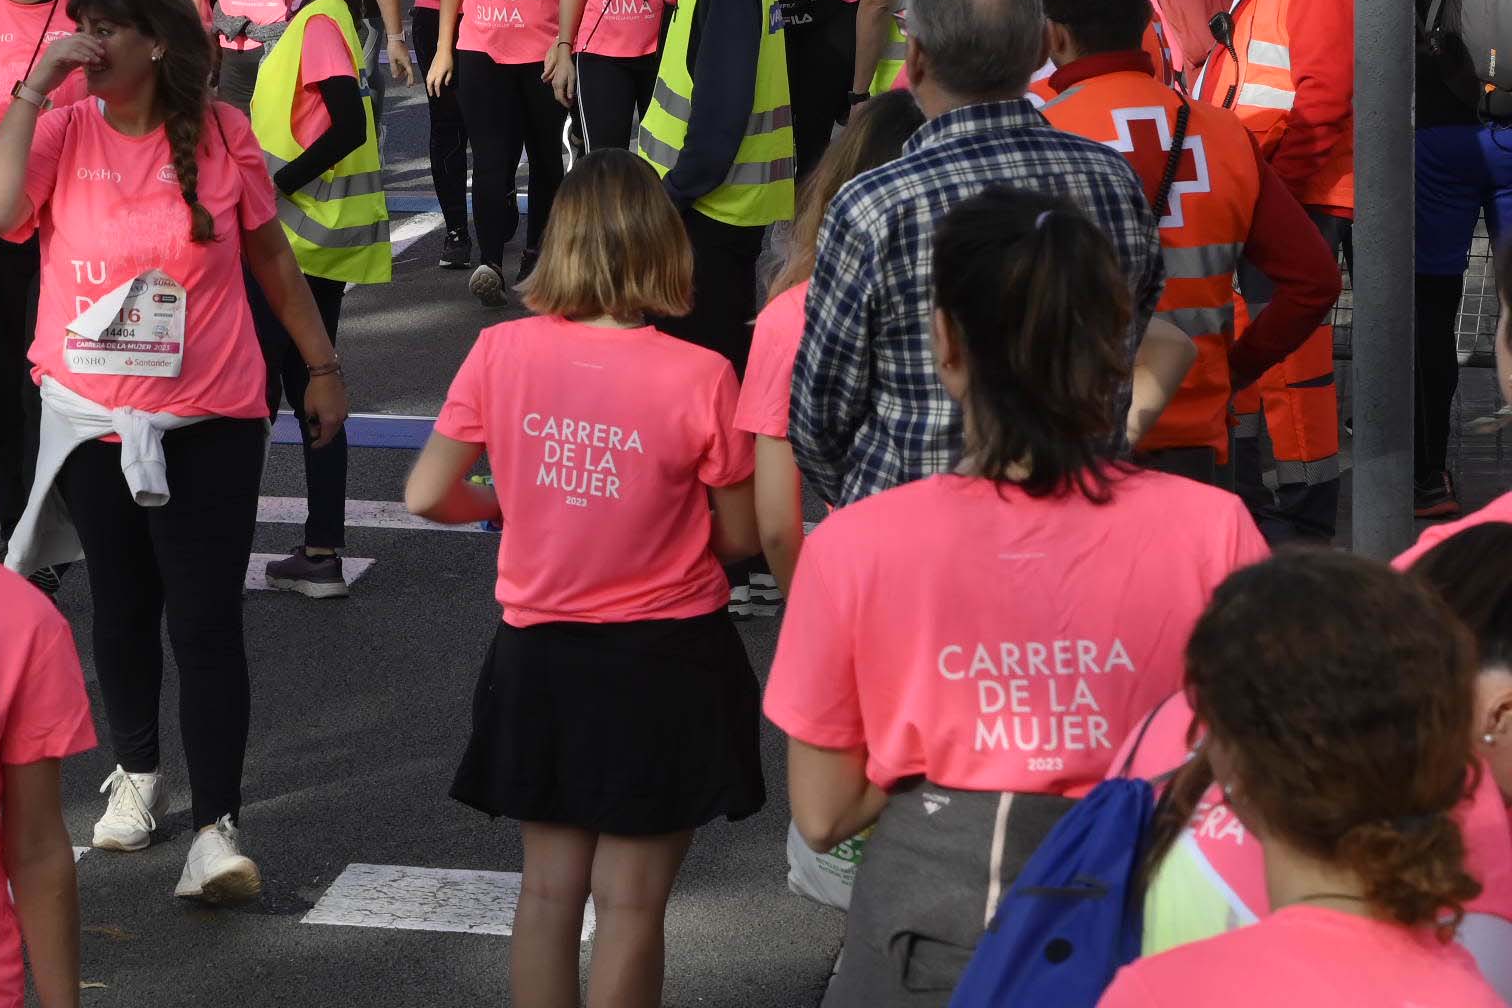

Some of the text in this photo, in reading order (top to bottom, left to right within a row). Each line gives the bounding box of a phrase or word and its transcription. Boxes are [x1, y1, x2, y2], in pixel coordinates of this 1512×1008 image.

[477, 6, 523, 23] SUMA
[602, 0, 653, 15] SUMA
[77, 167, 122, 183] OYSHO
[71, 260, 107, 285] TU
[76, 341, 105, 350] CARRERA
[117, 342, 126, 350] LA
[127, 343, 152, 351] MUJER
[73, 356, 172, 367] OYSHO Santander
[523, 413, 644, 454] CARRERA
[544, 440, 616, 474] DE LA
[536, 464, 620, 499] MUJER
[565, 495, 588, 507] 2023
[938, 638, 1135, 680] CARRERA
[978, 679, 1100, 714] DE LA
[974, 715, 1112, 752] MUJER
[1027, 757, 1064, 772] 2023
